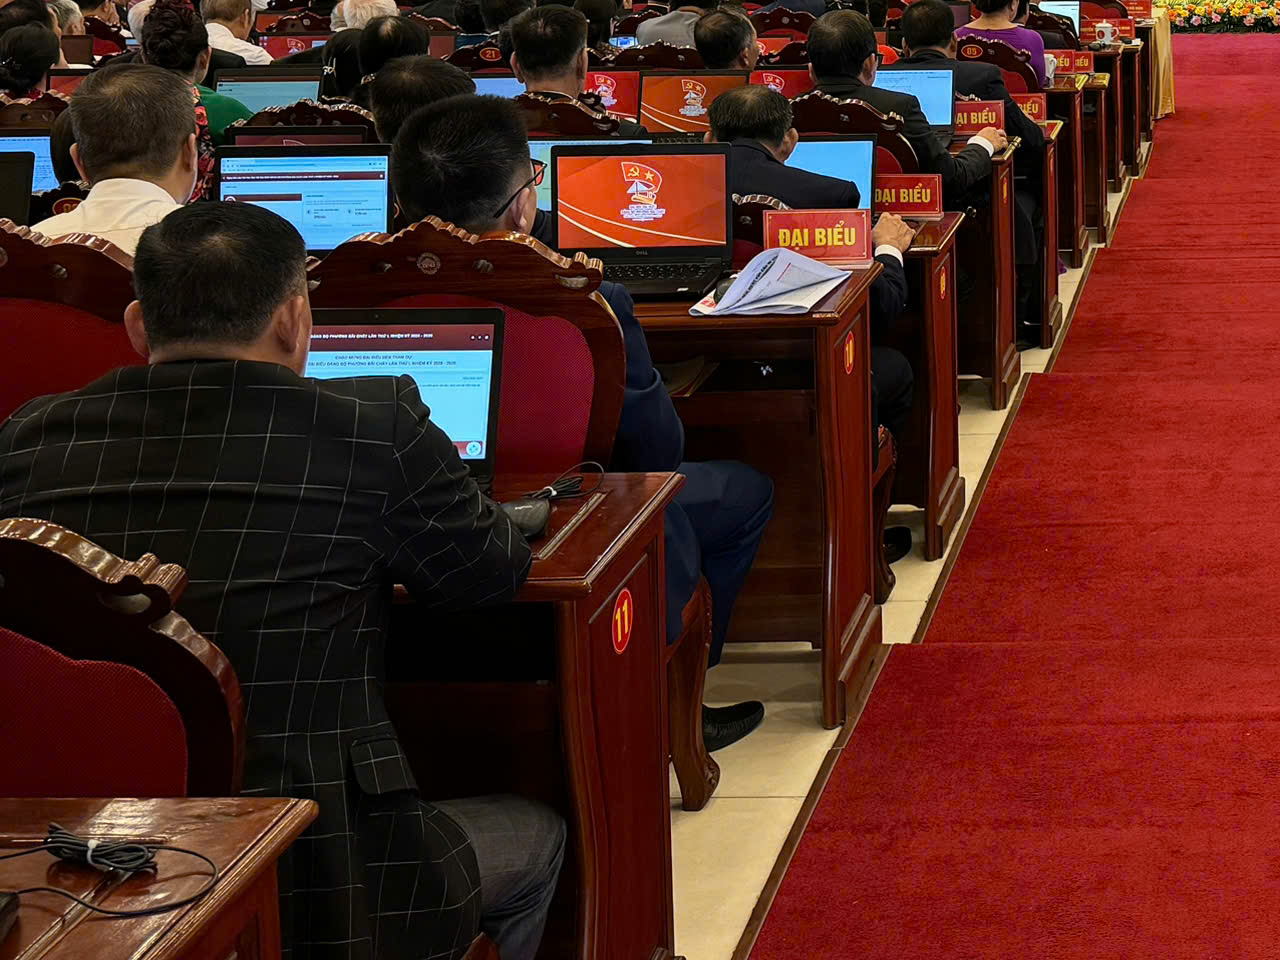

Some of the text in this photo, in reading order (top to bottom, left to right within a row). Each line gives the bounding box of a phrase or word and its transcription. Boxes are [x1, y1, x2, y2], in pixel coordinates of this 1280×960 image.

[484, 49, 496, 58] 21
[971, 107, 996, 124] BIỂU
[900, 182, 931, 203] BIỂU
[778, 220, 856, 251] ĐẠI BIỂU
[614, 600, 630, 643] 11
